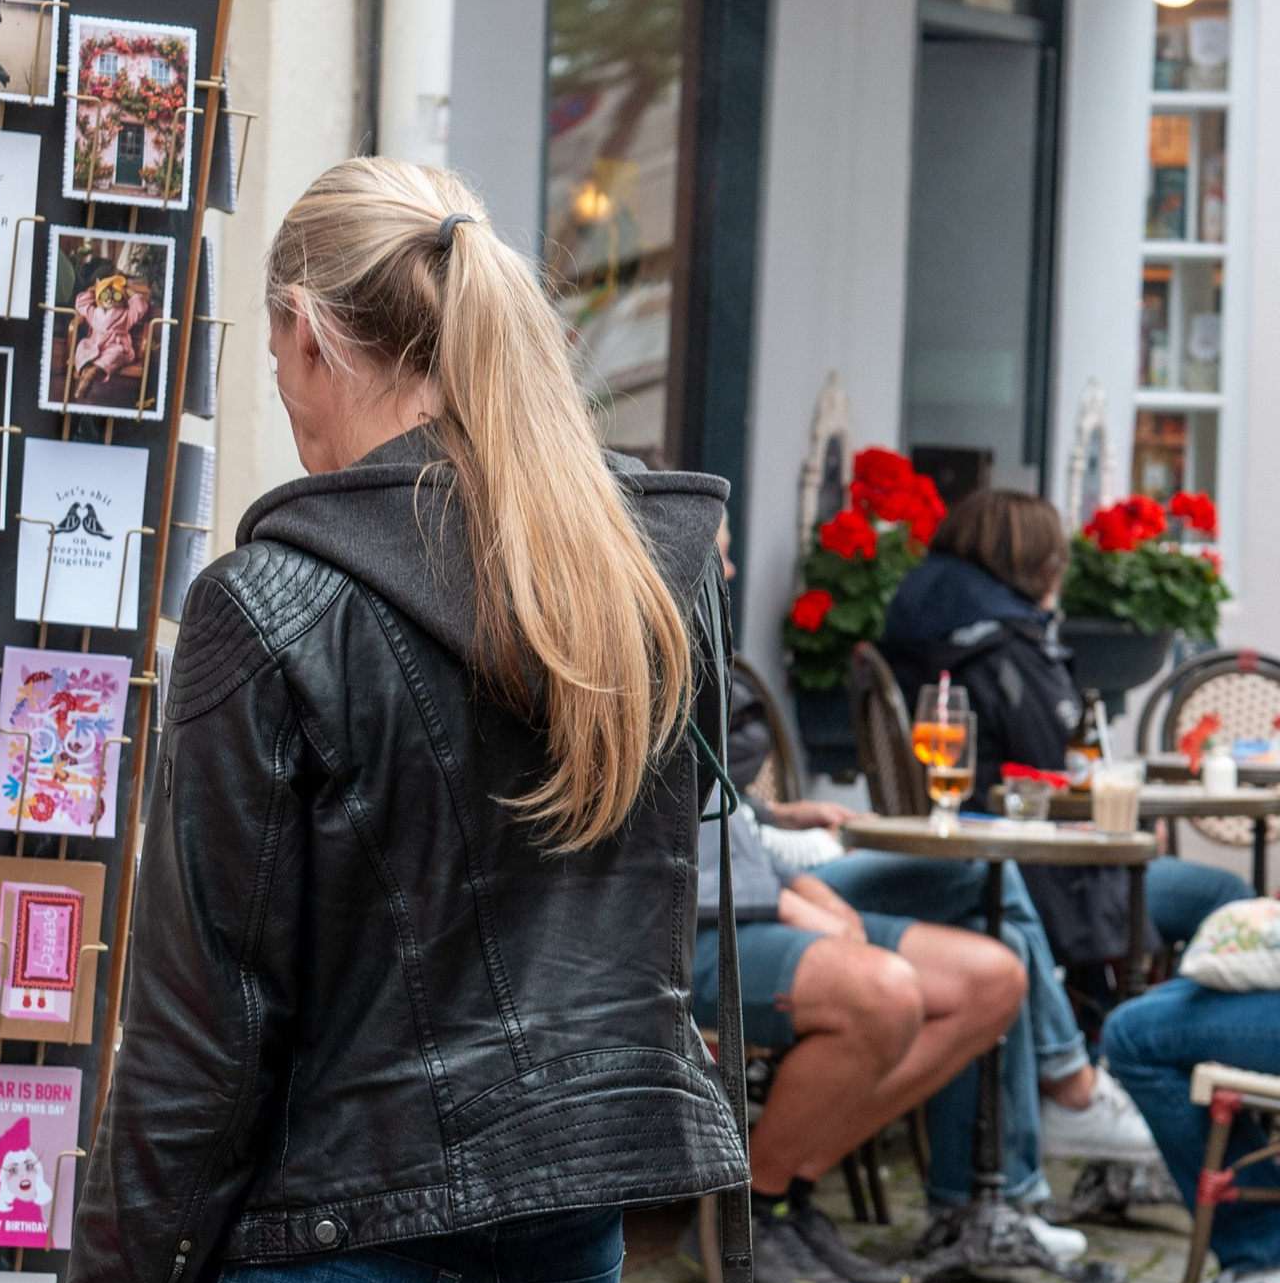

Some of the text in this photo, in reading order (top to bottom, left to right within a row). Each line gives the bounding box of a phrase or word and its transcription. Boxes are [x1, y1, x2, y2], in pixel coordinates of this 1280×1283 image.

[56, 485, 112, 506] Let's shit
[73, 537, 87, 545] on
[53, 556, 104, 568] together
[33, 908, 58, 974] PERFECT
[19, 1083, 31, 1099] IS
[35, 1083, 72, 1102] BORN
[12, 1103, 23, 1112] ON
[25, 1103, 46, 1114] THIS
[49, 1105, 65, 1115] DAY
[5, 1221, 48, 1233] BIRTHDAY
